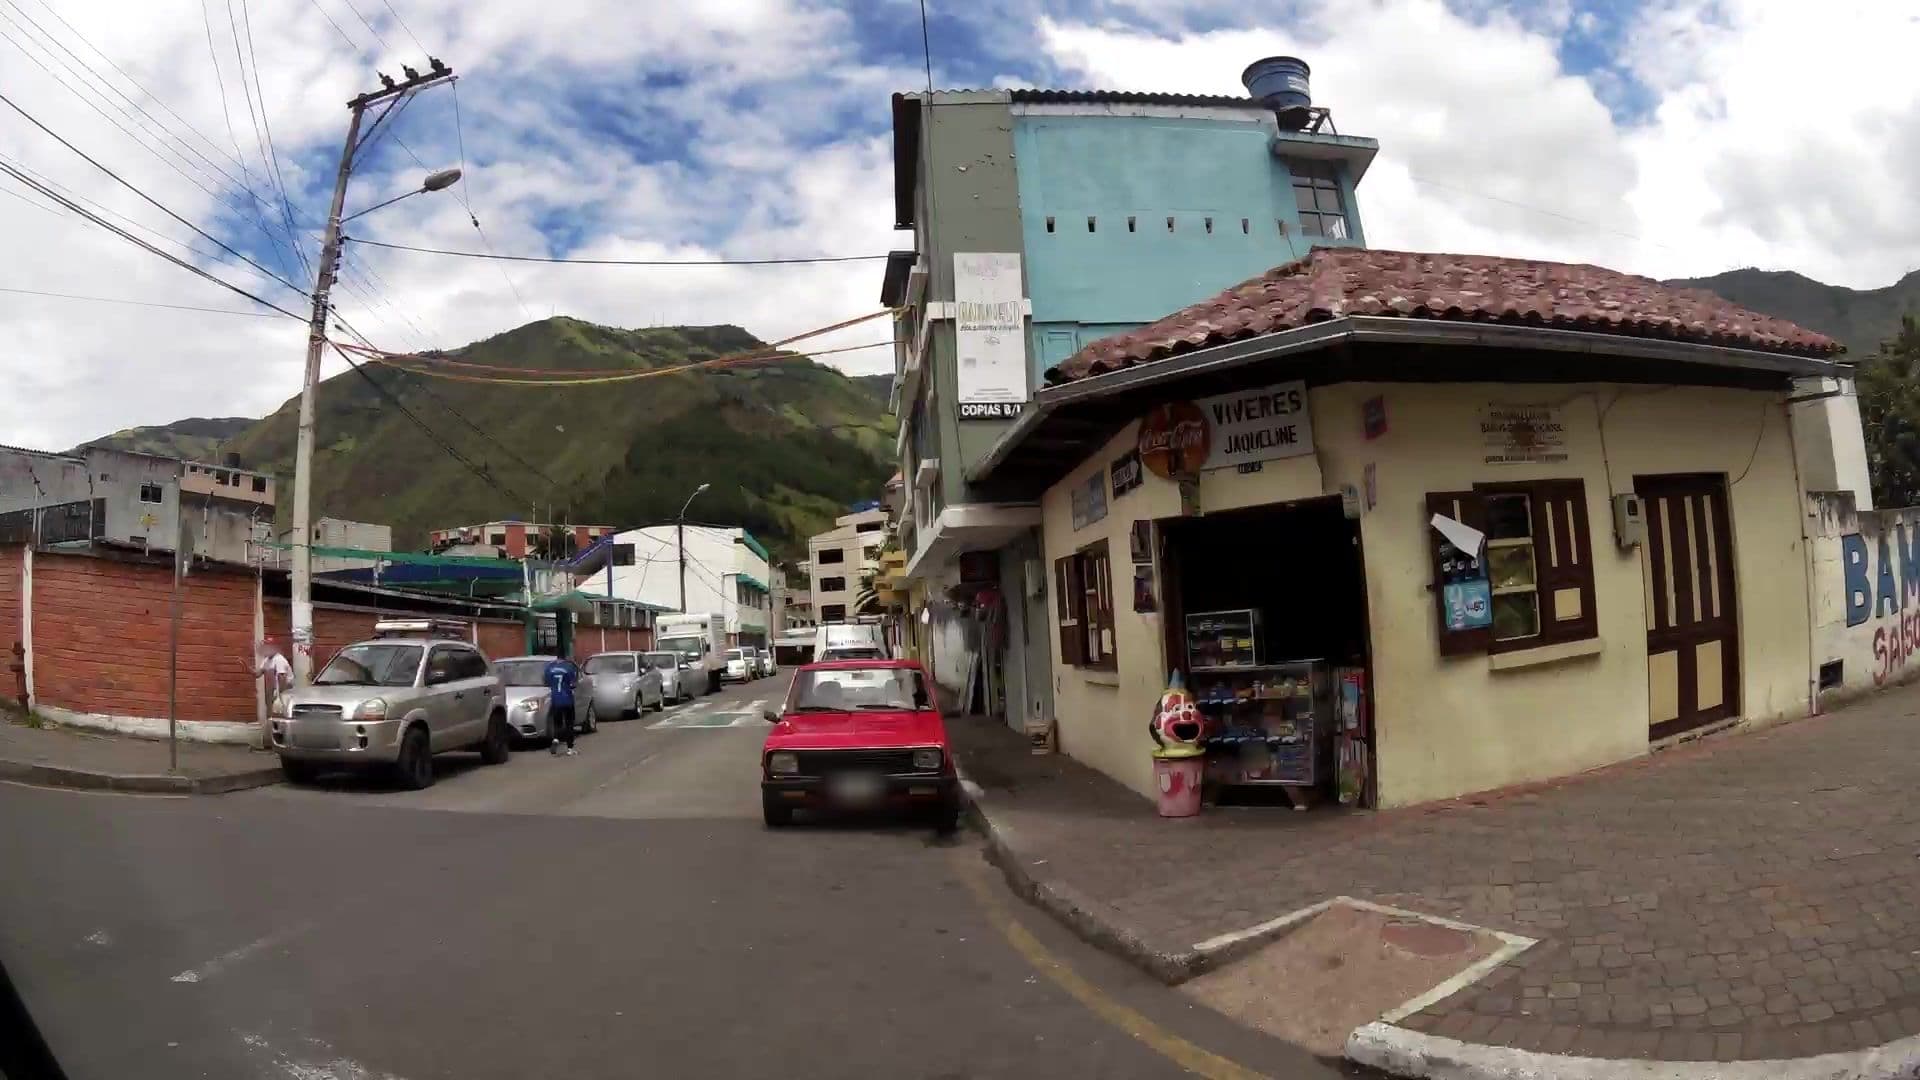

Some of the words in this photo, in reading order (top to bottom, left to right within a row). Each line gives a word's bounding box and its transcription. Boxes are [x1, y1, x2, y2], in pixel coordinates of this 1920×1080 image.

[961, 404, 1001, 416] COPIAS
[1212, 389, 1302, 425] VIVERES
[1224, 424, 1298, 454] JAQUELINE
[553, 674, 563, 693] 7
